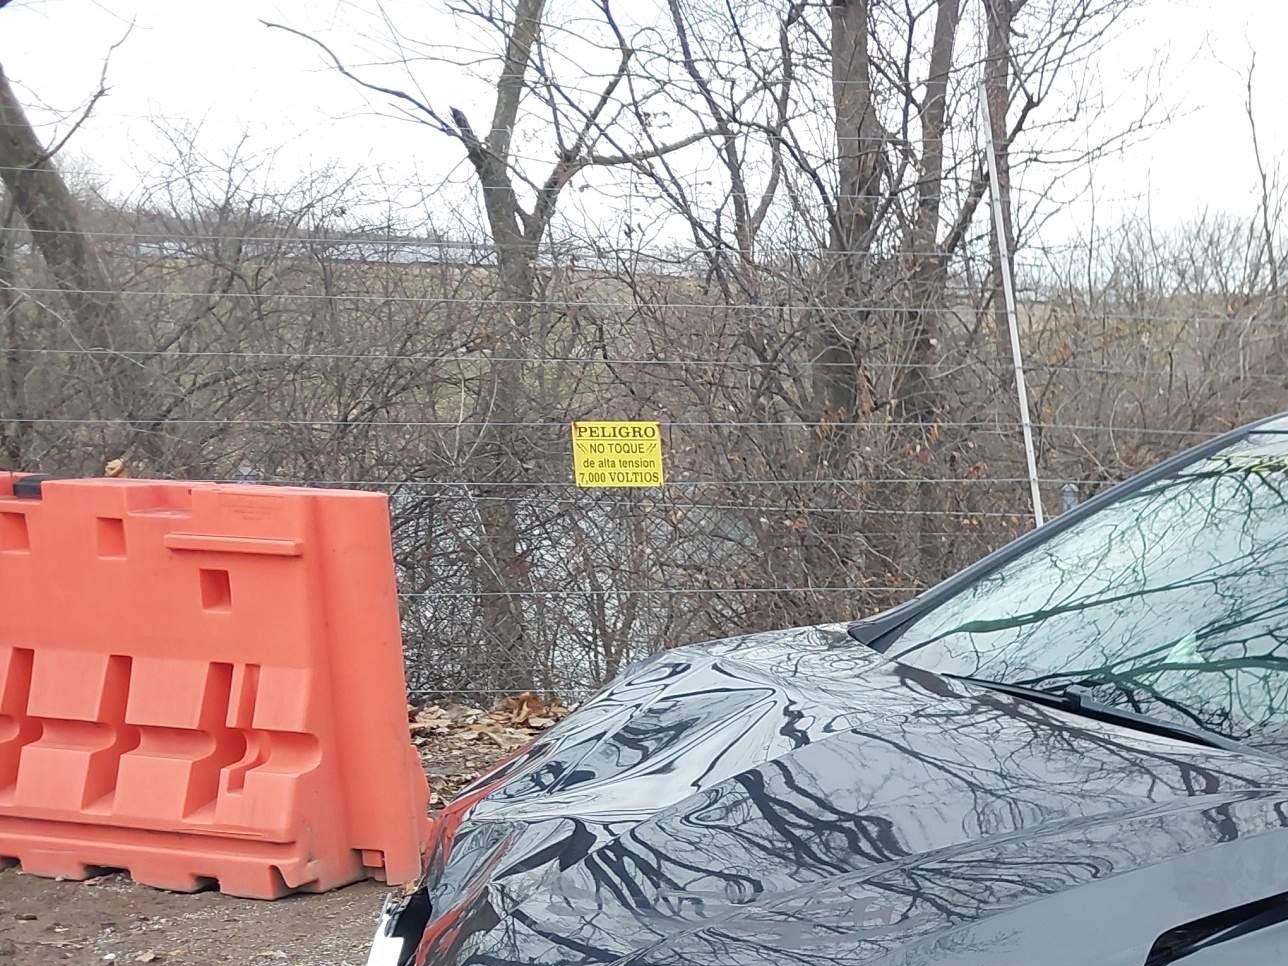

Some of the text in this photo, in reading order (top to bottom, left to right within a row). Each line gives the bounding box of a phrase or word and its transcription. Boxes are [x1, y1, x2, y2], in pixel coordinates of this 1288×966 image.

[577, 426, 656, 438] PELIGRO
[589, 443, 645, 454] NO TOQUE
[583, 458, 656, 468] de alta tension
[579, 471, 660, 484] 7,000 VOLTIOS
